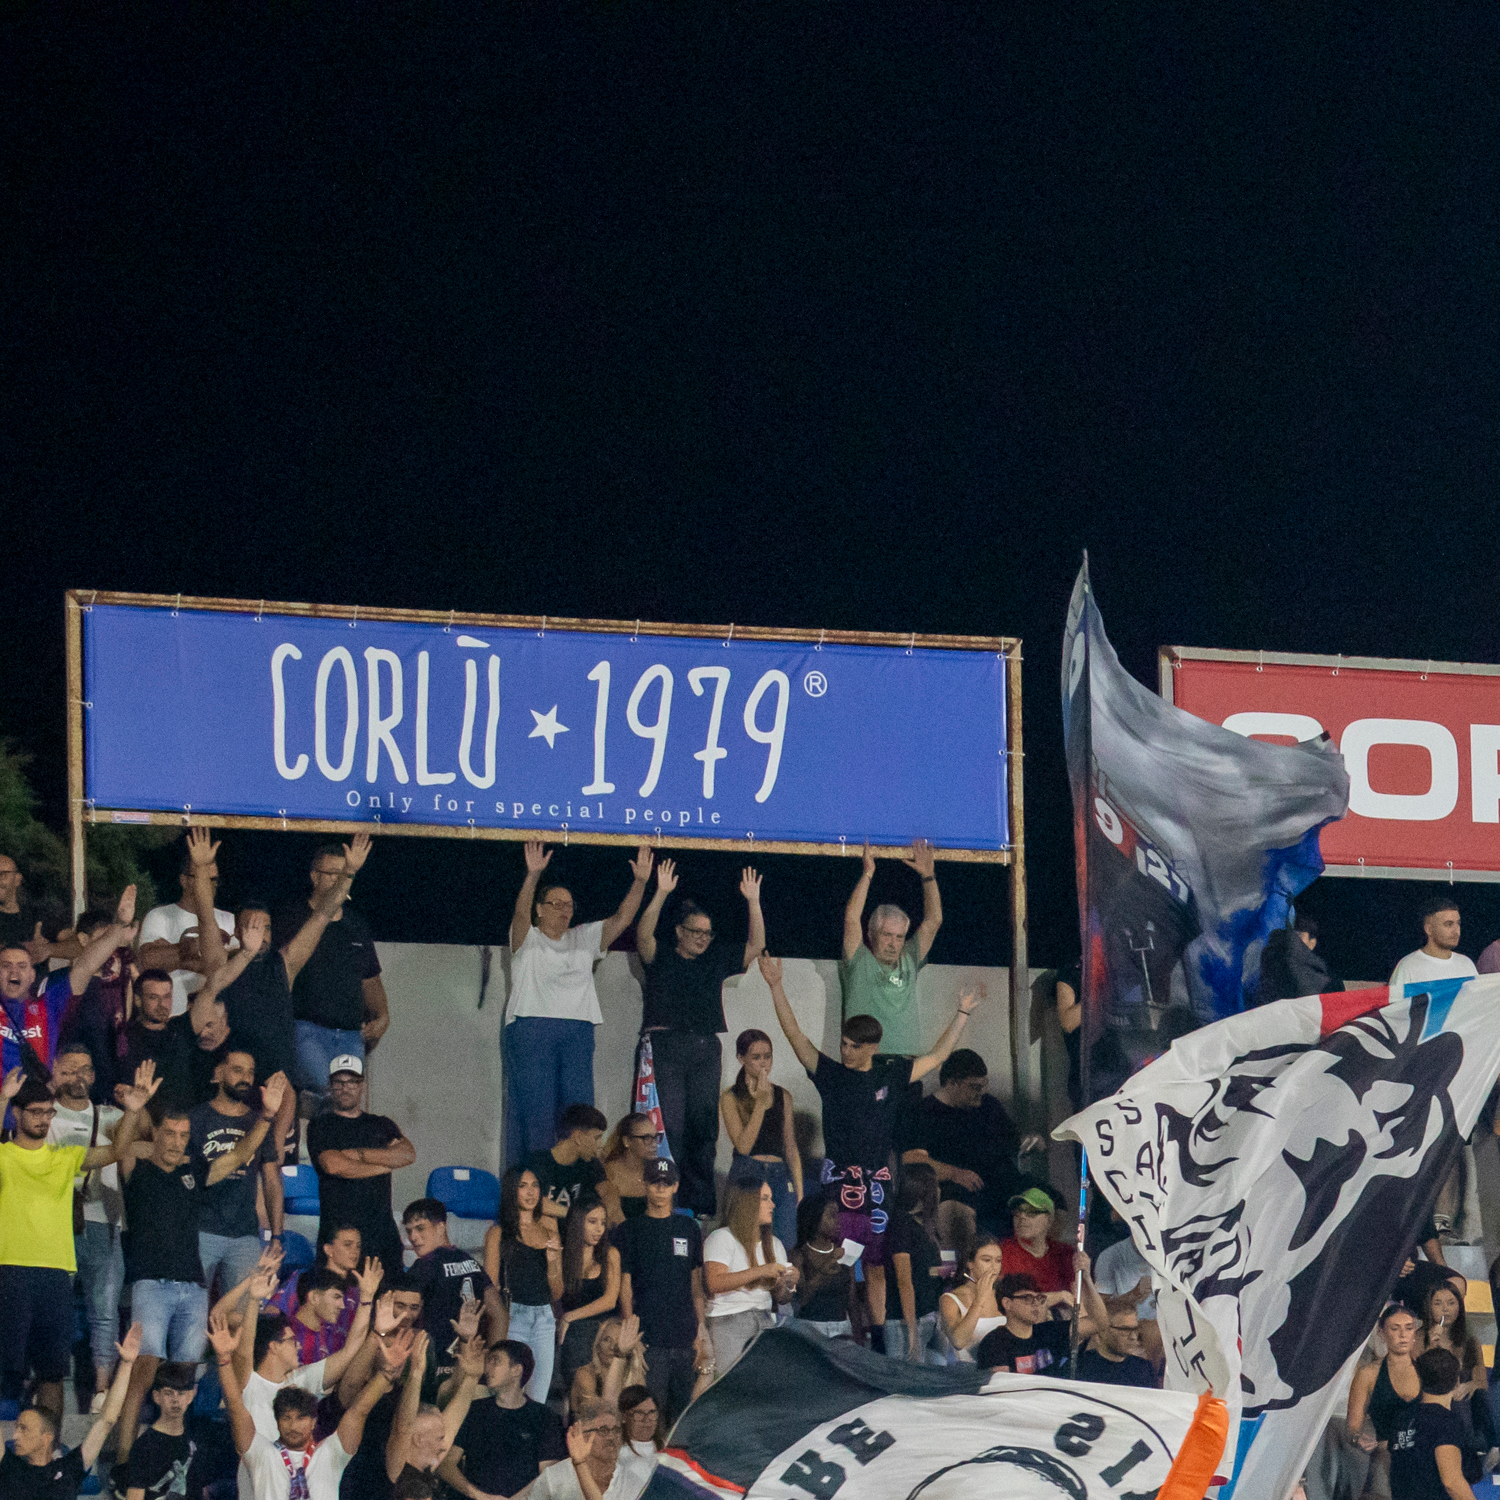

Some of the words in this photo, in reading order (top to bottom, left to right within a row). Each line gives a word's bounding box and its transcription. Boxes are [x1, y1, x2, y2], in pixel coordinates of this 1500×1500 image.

[271, 635, 501, 790] CORLÙ
[347, 790, 414, 814] Only
[434, 793, 477, 814] for
[496, 797, 605, 822] special
[625, 804, 723, 827] people
